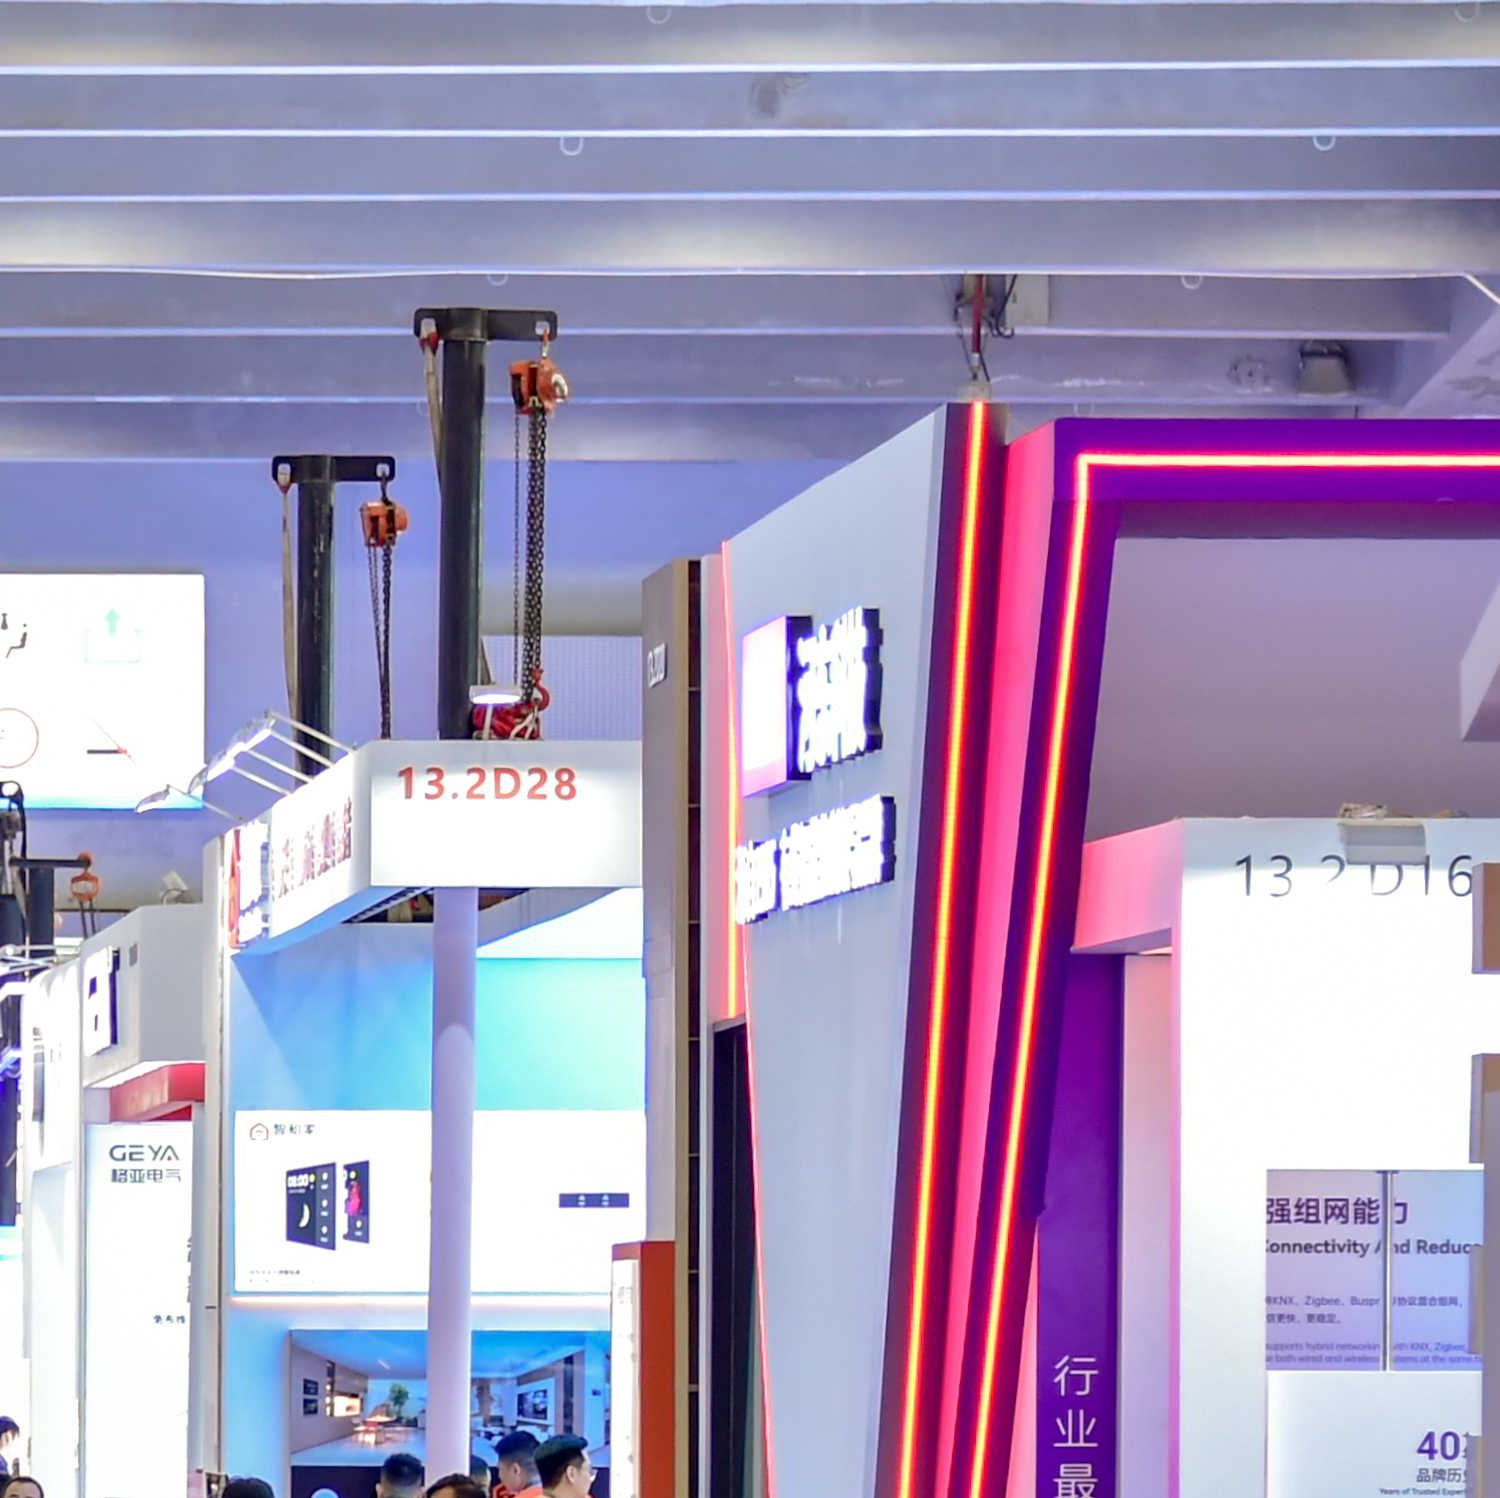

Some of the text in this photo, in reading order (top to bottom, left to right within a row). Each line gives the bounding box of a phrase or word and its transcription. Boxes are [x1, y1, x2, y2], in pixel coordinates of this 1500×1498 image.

[397, 765, 577, 801] 13.2D28
[108, 1144, 180, 1162] GEYA
[110, 1167, 182, 1184] 格亚电气
